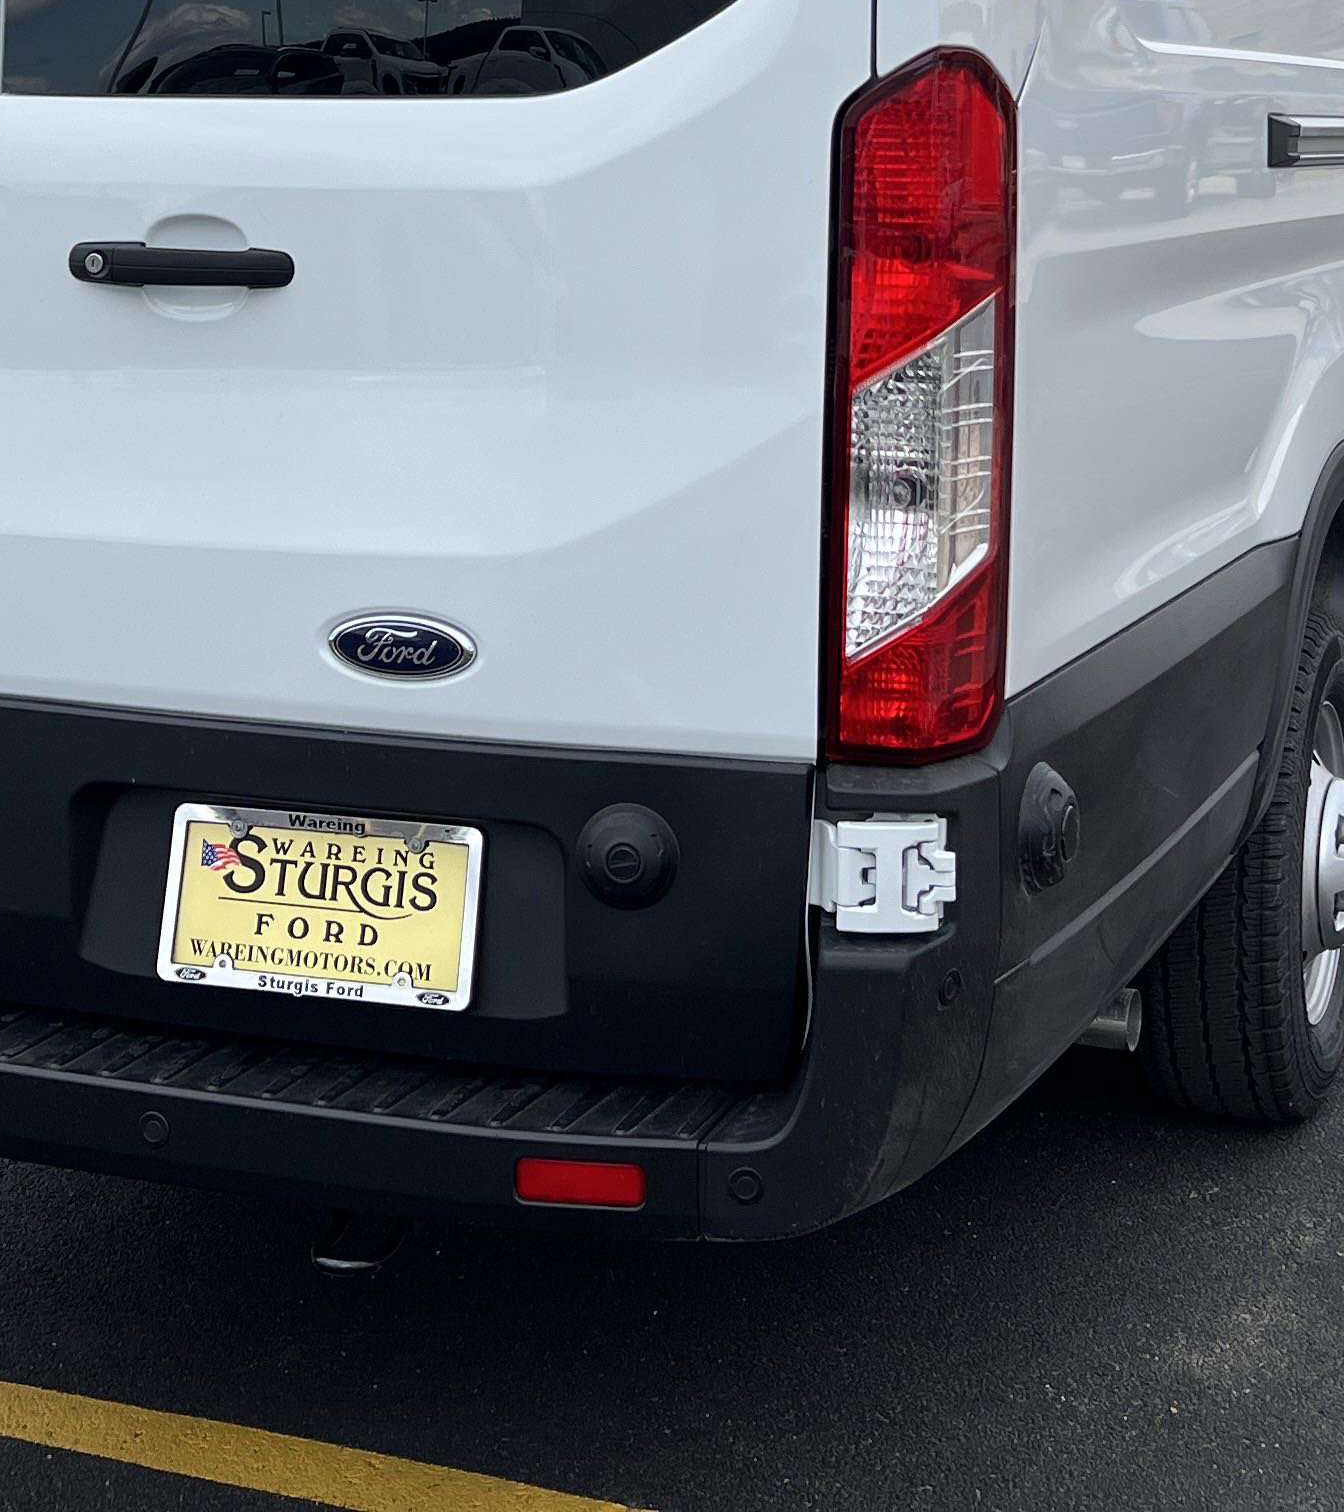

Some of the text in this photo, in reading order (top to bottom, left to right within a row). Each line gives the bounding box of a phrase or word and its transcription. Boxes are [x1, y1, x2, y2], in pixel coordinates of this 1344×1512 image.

[357, 627, 439, 666] Ford
[288, 813, 366, 835] Wareing
[271, 838, 435, 870] WAREING
[222, 834, 439, 918] STURGIS
[254, 913, 379, 947] FORD
[258, 975, 364, 999] Sturgis Ford
